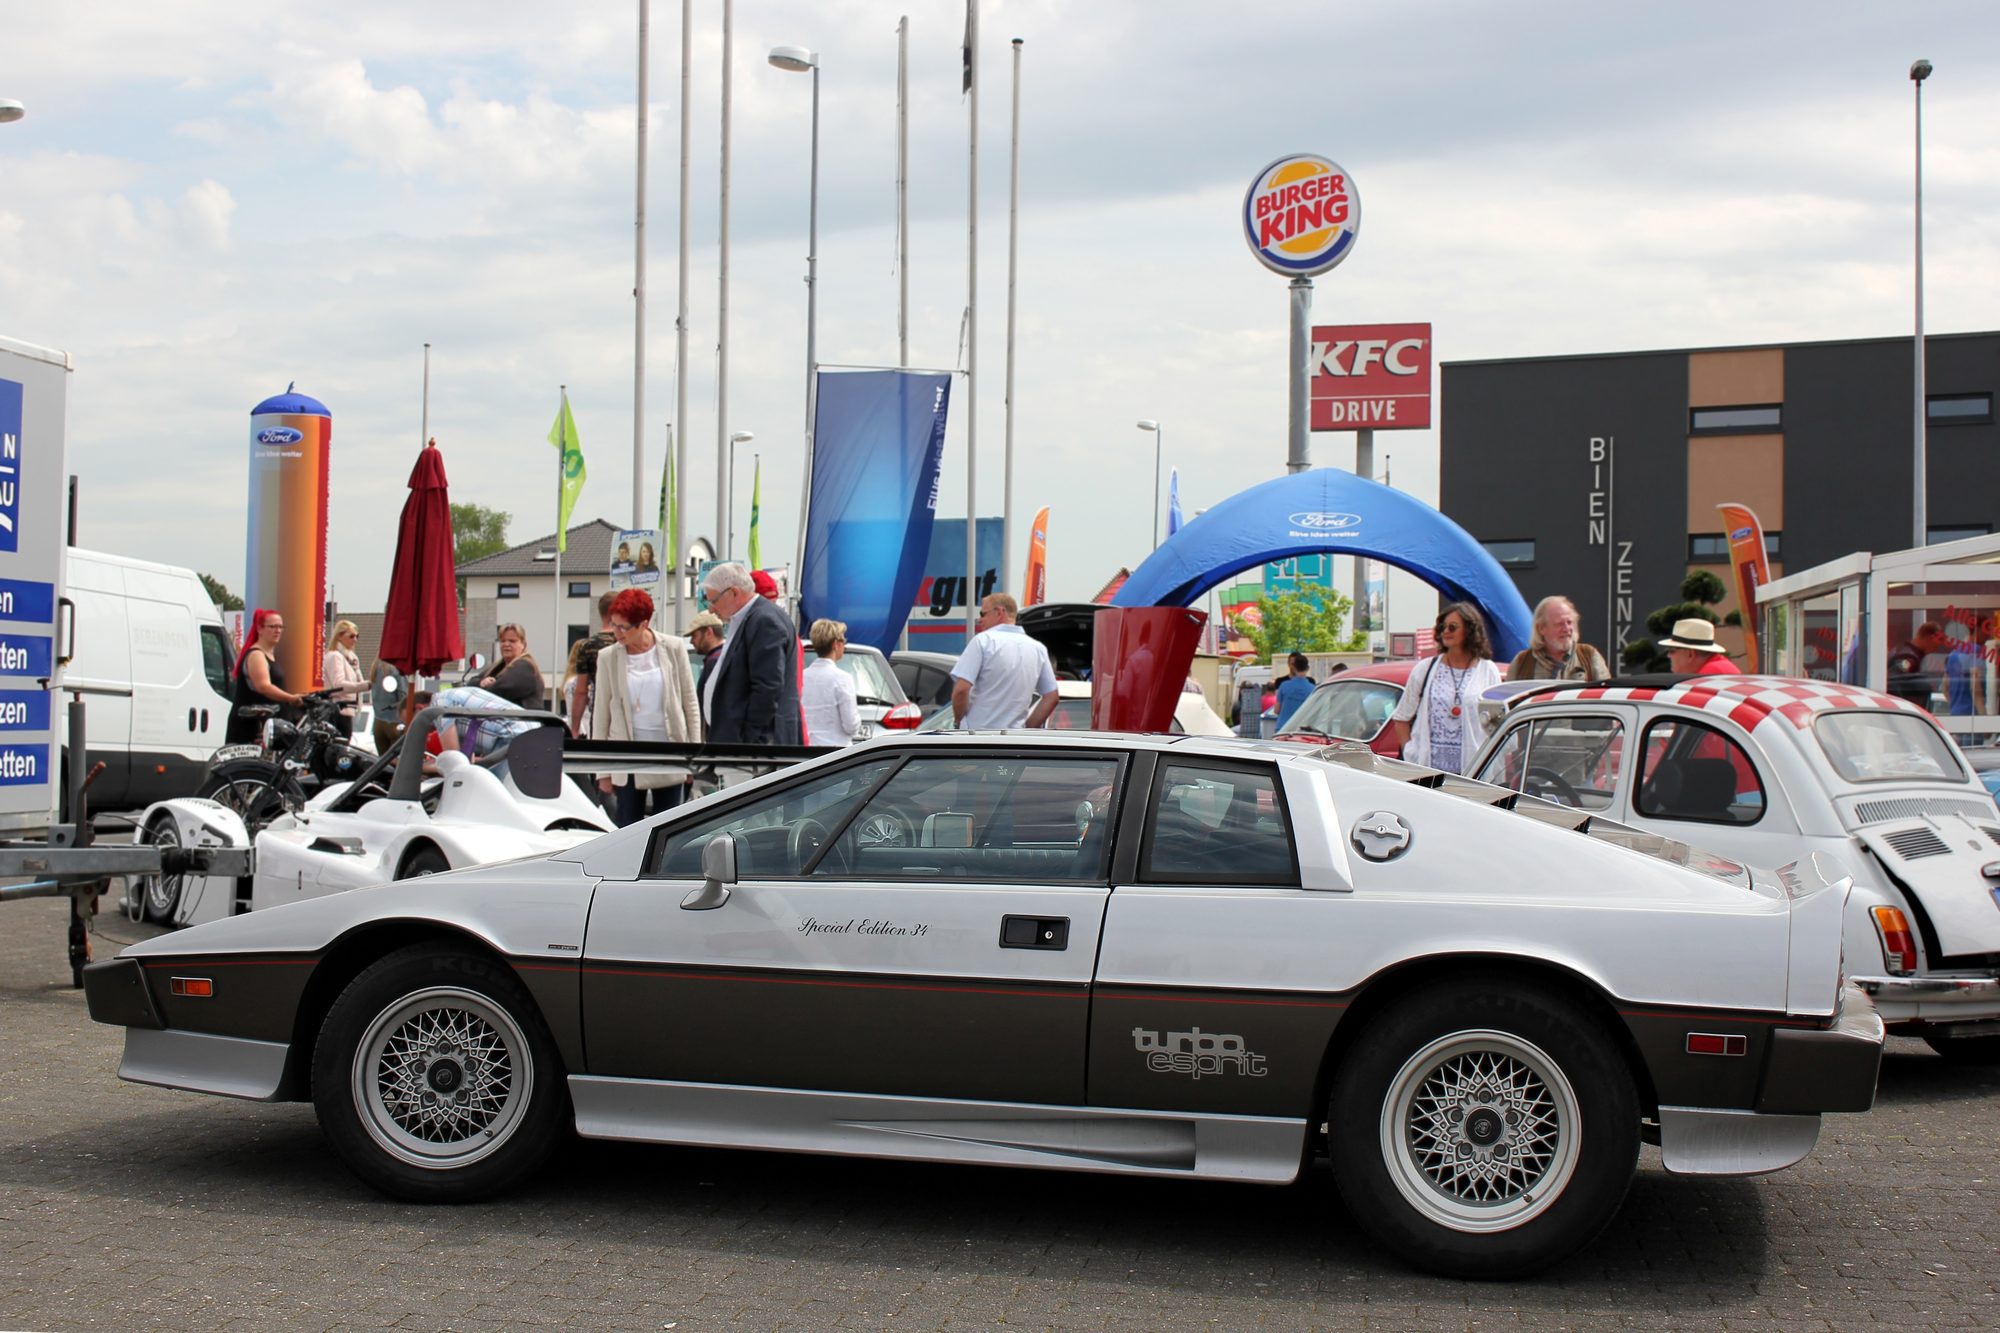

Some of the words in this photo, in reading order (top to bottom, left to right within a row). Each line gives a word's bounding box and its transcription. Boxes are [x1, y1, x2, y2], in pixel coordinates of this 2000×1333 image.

[1256, 174, 1345, 219] BURGER
[1259, 194, 1349, 249] KING
[1310, 339, 1423, 377] KFC
[1331, 400, 1396, 422] DRIVE
[1589, 437, 1605, 545] BIEN
[1301, 512, 1349, 527] Ford
[798, 917, 851, 937] Special
[857, 919, 907, 937] Edition
[910, 923, 930, 937] 34
[1132, 1027, 1246, 1056] turbo
[1147, 1050, 1268, 1080] esprit
